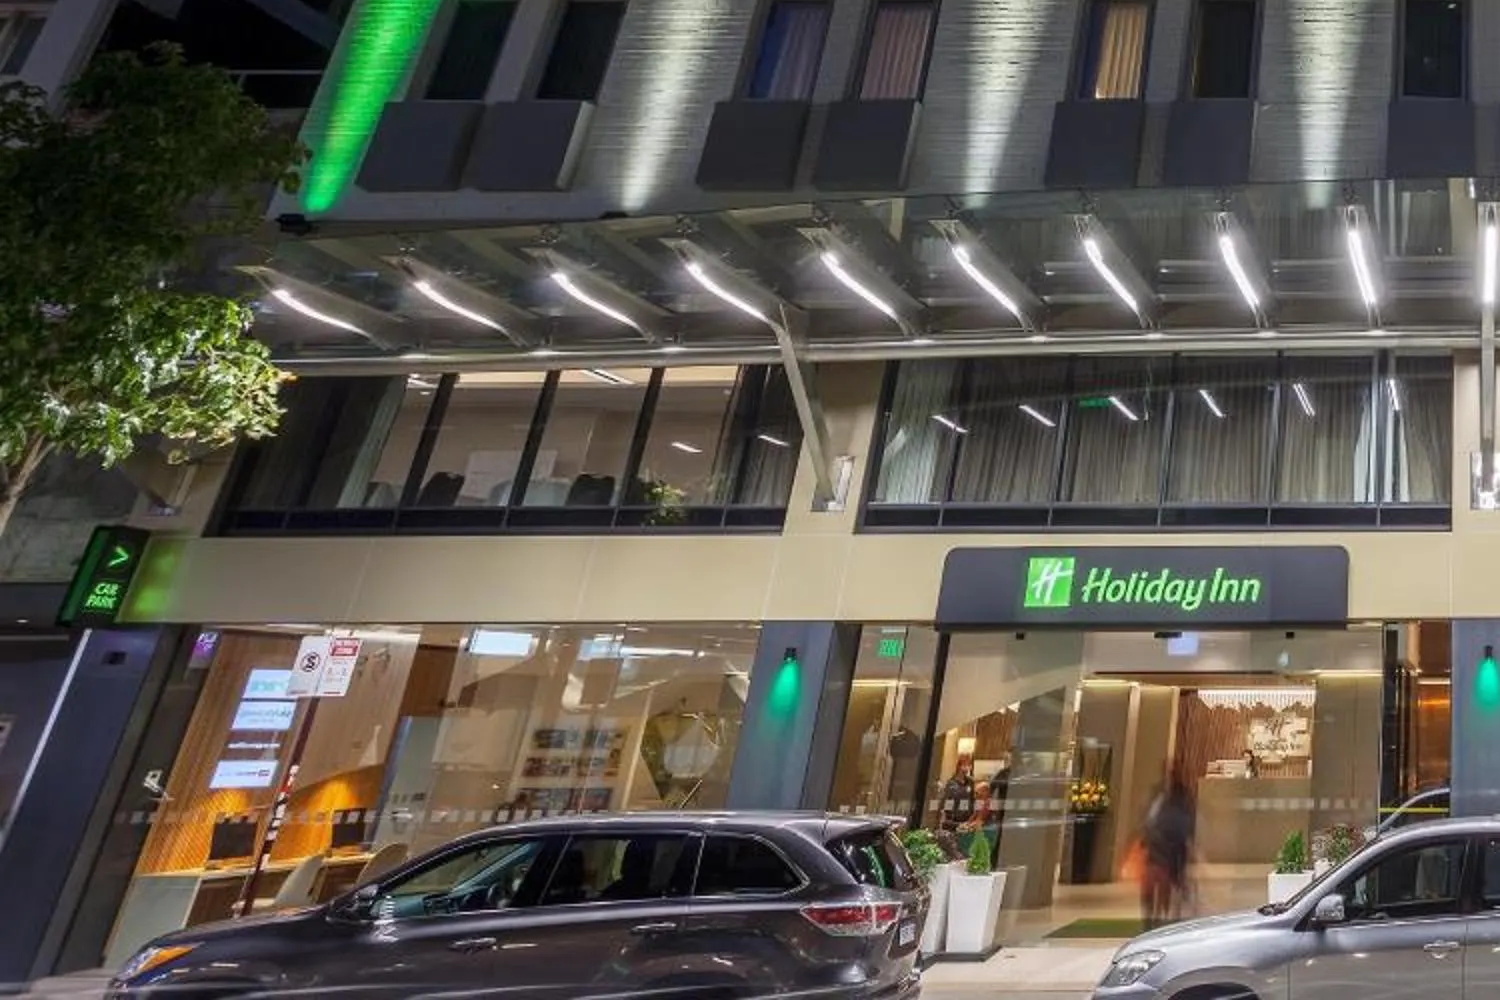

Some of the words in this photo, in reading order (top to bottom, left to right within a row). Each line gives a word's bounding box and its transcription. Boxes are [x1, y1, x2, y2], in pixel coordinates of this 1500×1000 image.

[94, 583, 119, 596] CAR
[1081, 567, 1206, 611] Holiday
[1209, 567, 1262, 603] Inn
[85, 593, 117, 609] PARK
